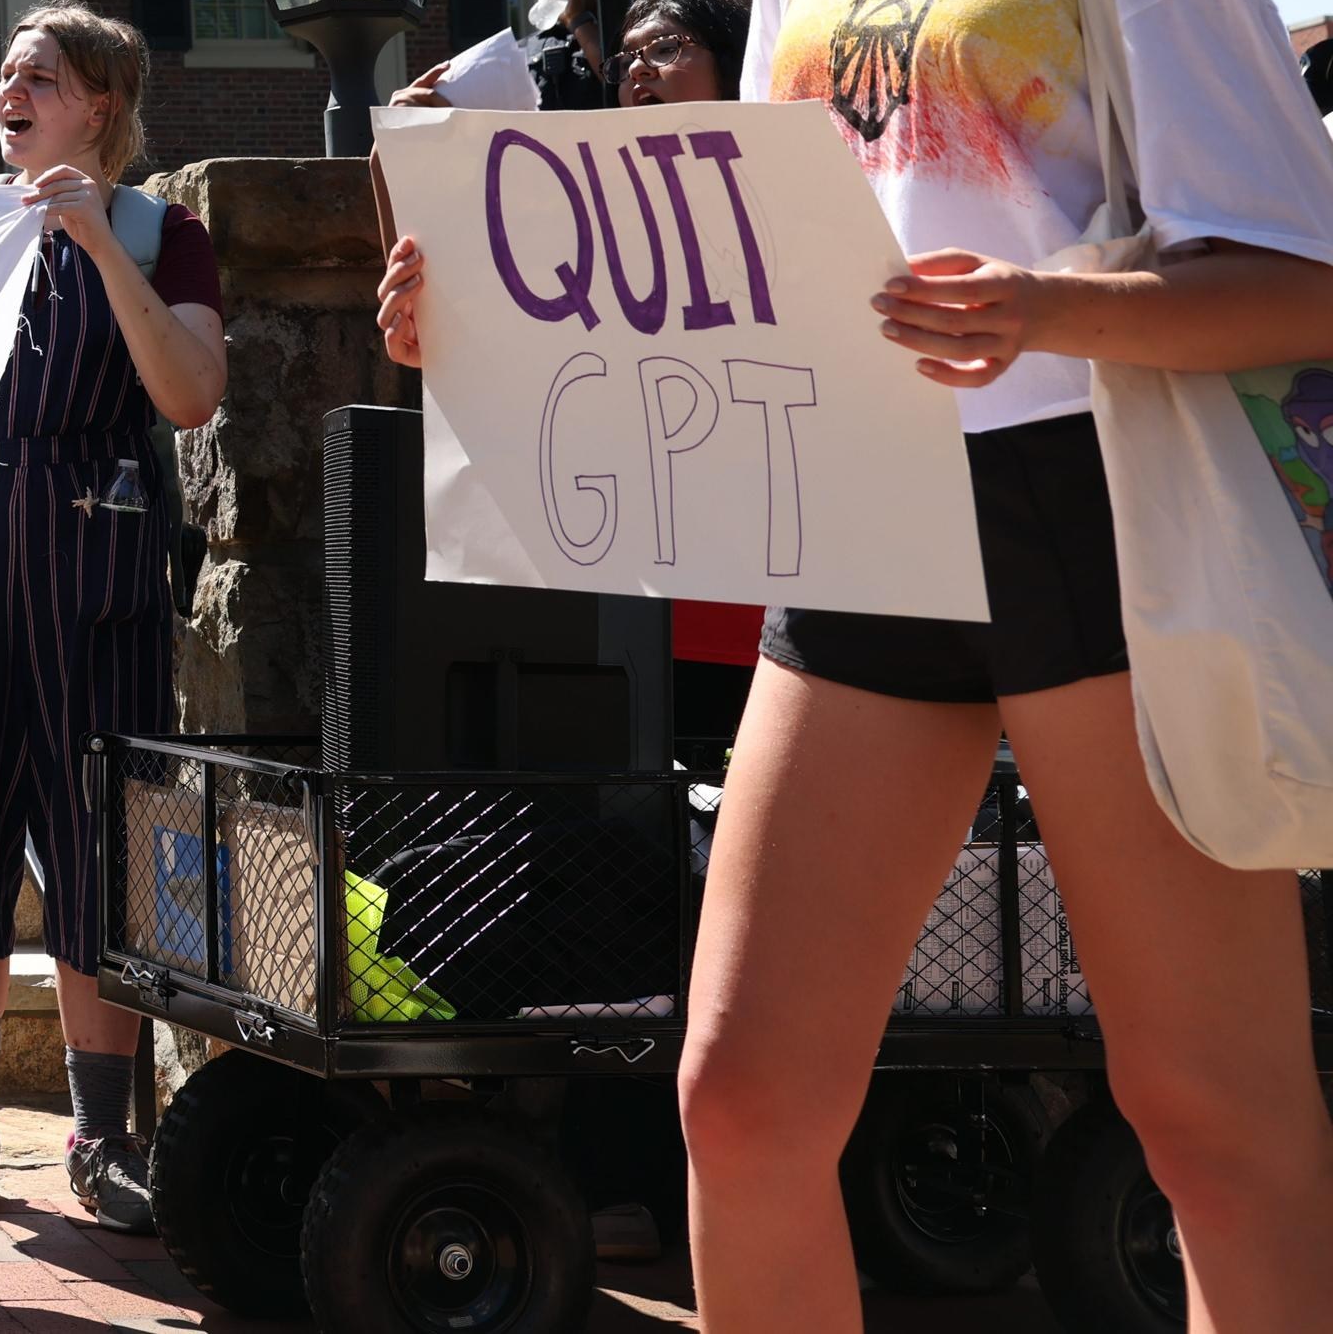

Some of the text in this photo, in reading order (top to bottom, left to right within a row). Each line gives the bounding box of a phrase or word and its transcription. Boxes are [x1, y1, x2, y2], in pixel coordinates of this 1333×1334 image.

[486, 129, 776, 335] QUIT
[540, 352, 816, 577] GPT
[1058, 916, 1069, 967] SOCIALISM
